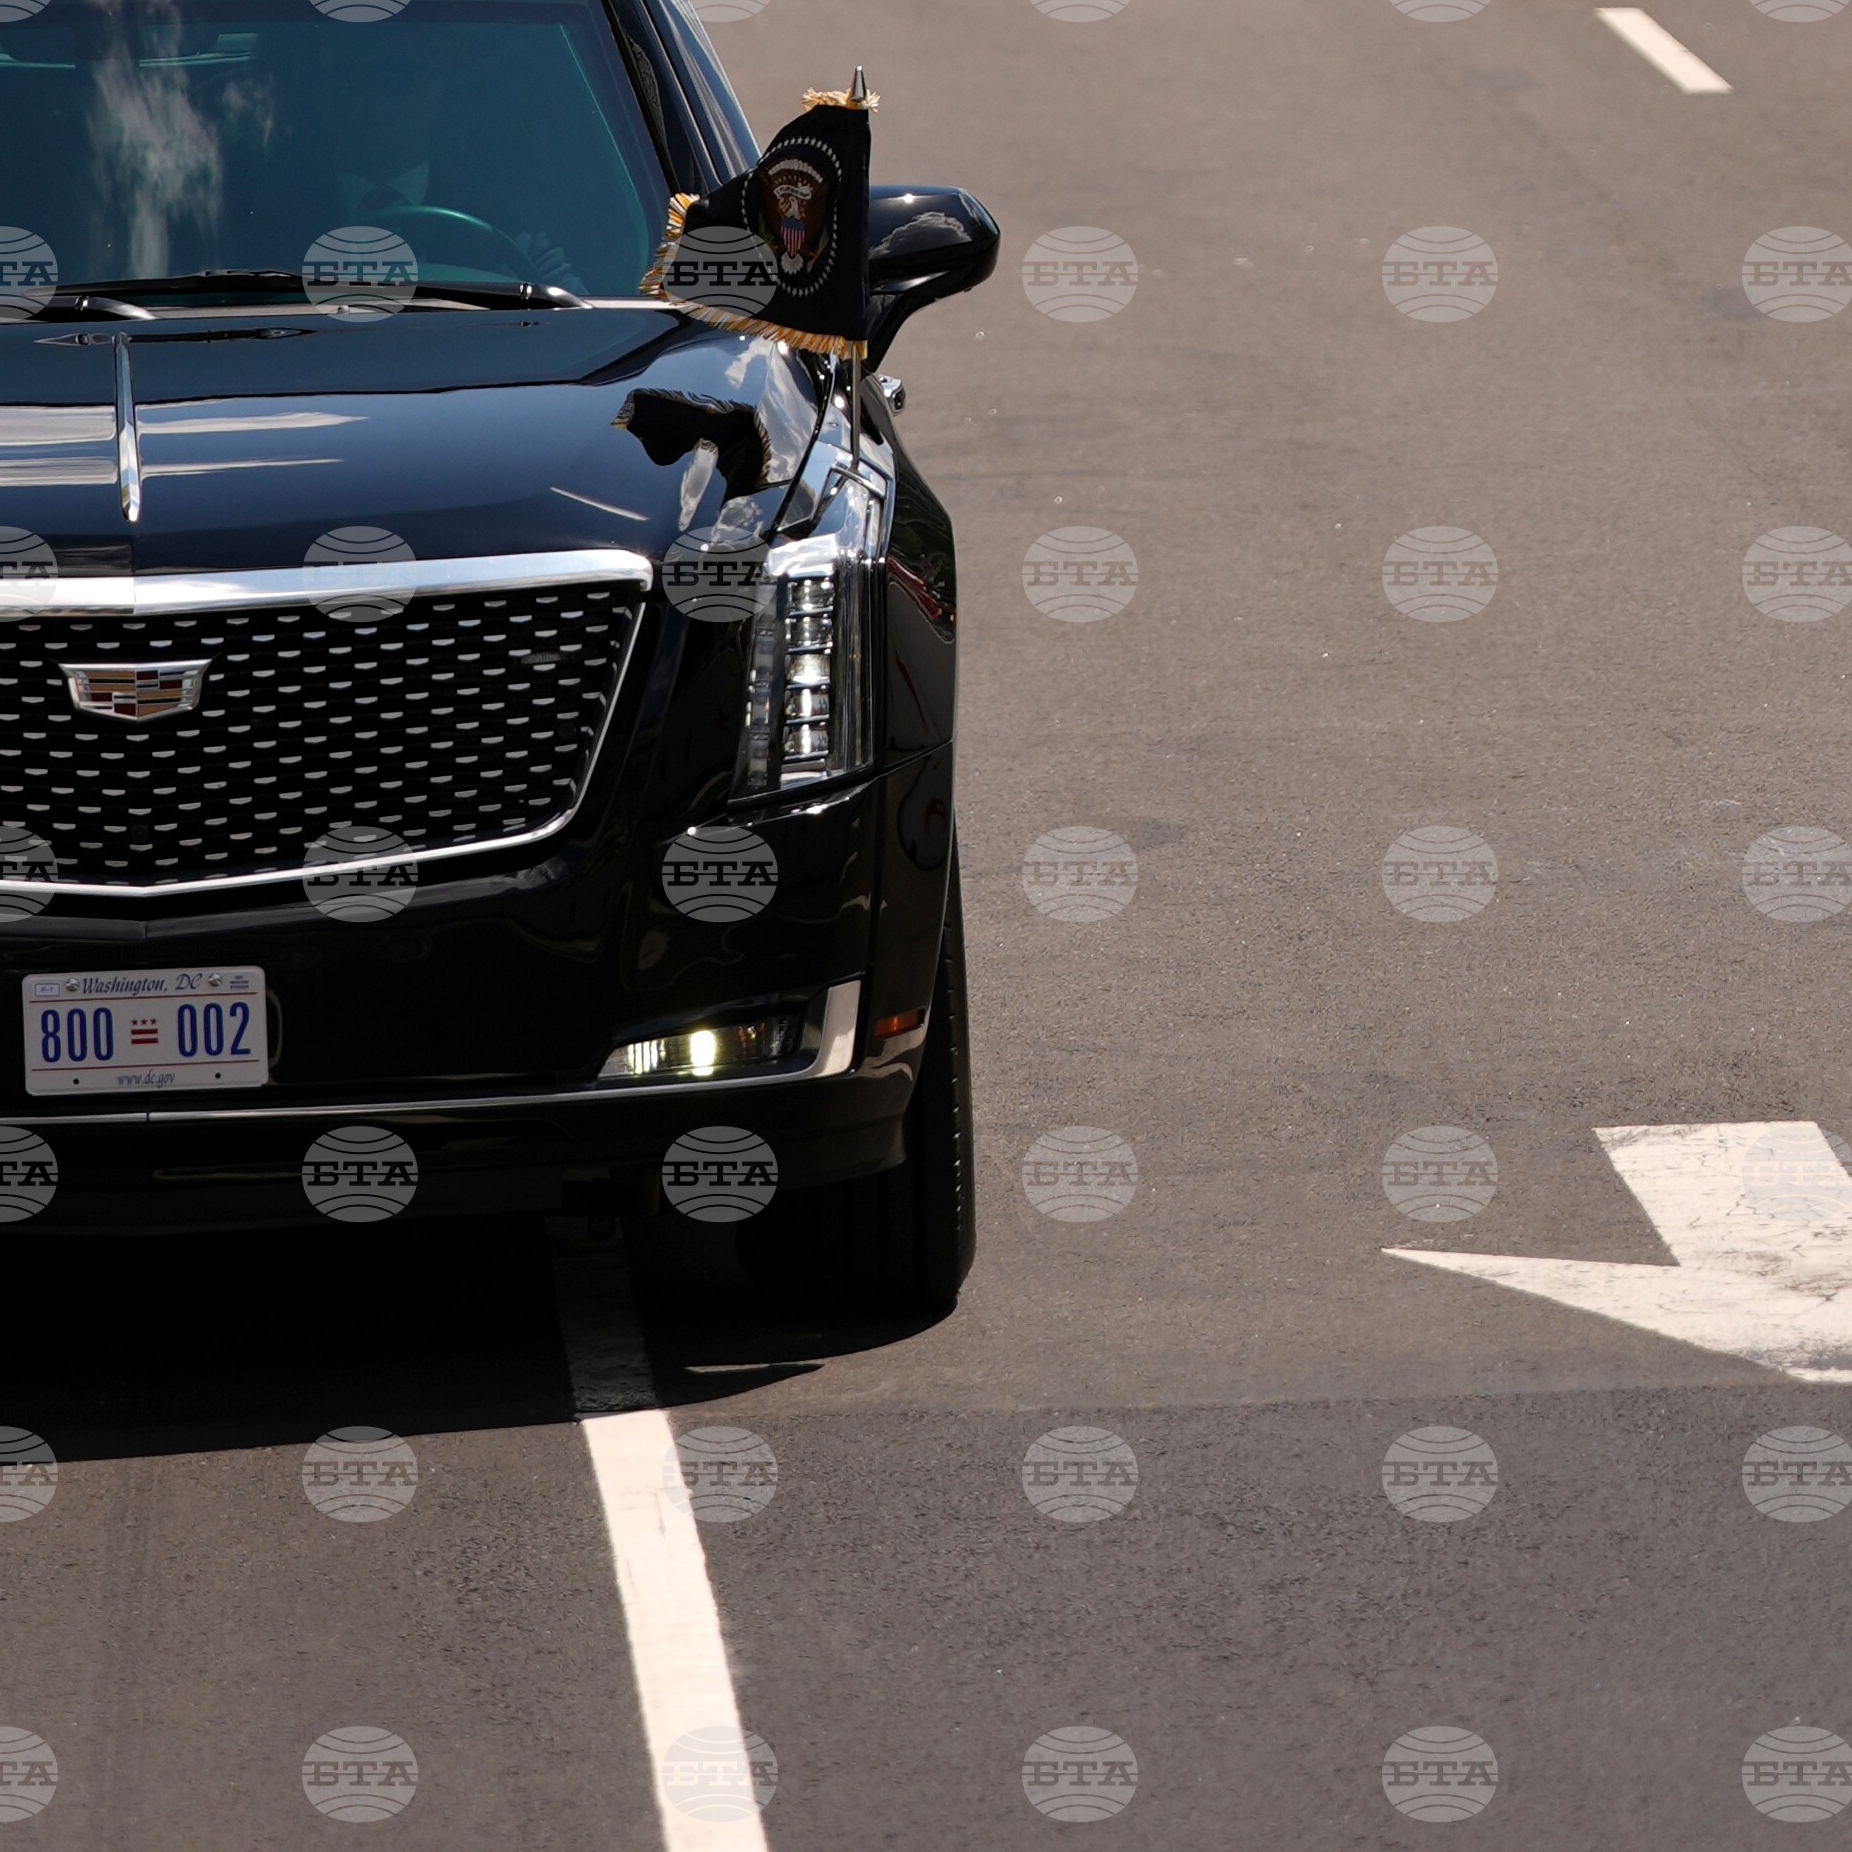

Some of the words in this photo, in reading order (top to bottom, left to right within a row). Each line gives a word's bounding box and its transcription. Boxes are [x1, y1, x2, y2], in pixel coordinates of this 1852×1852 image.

[81, 977, 168, 996] Washington,
[175, 972, 204, 991] DC
[40, 1006, 114, 1063] 800
[177, 1001, 251, 1057] 002
[116, 1069, 176, 1088] www.dc.gov
